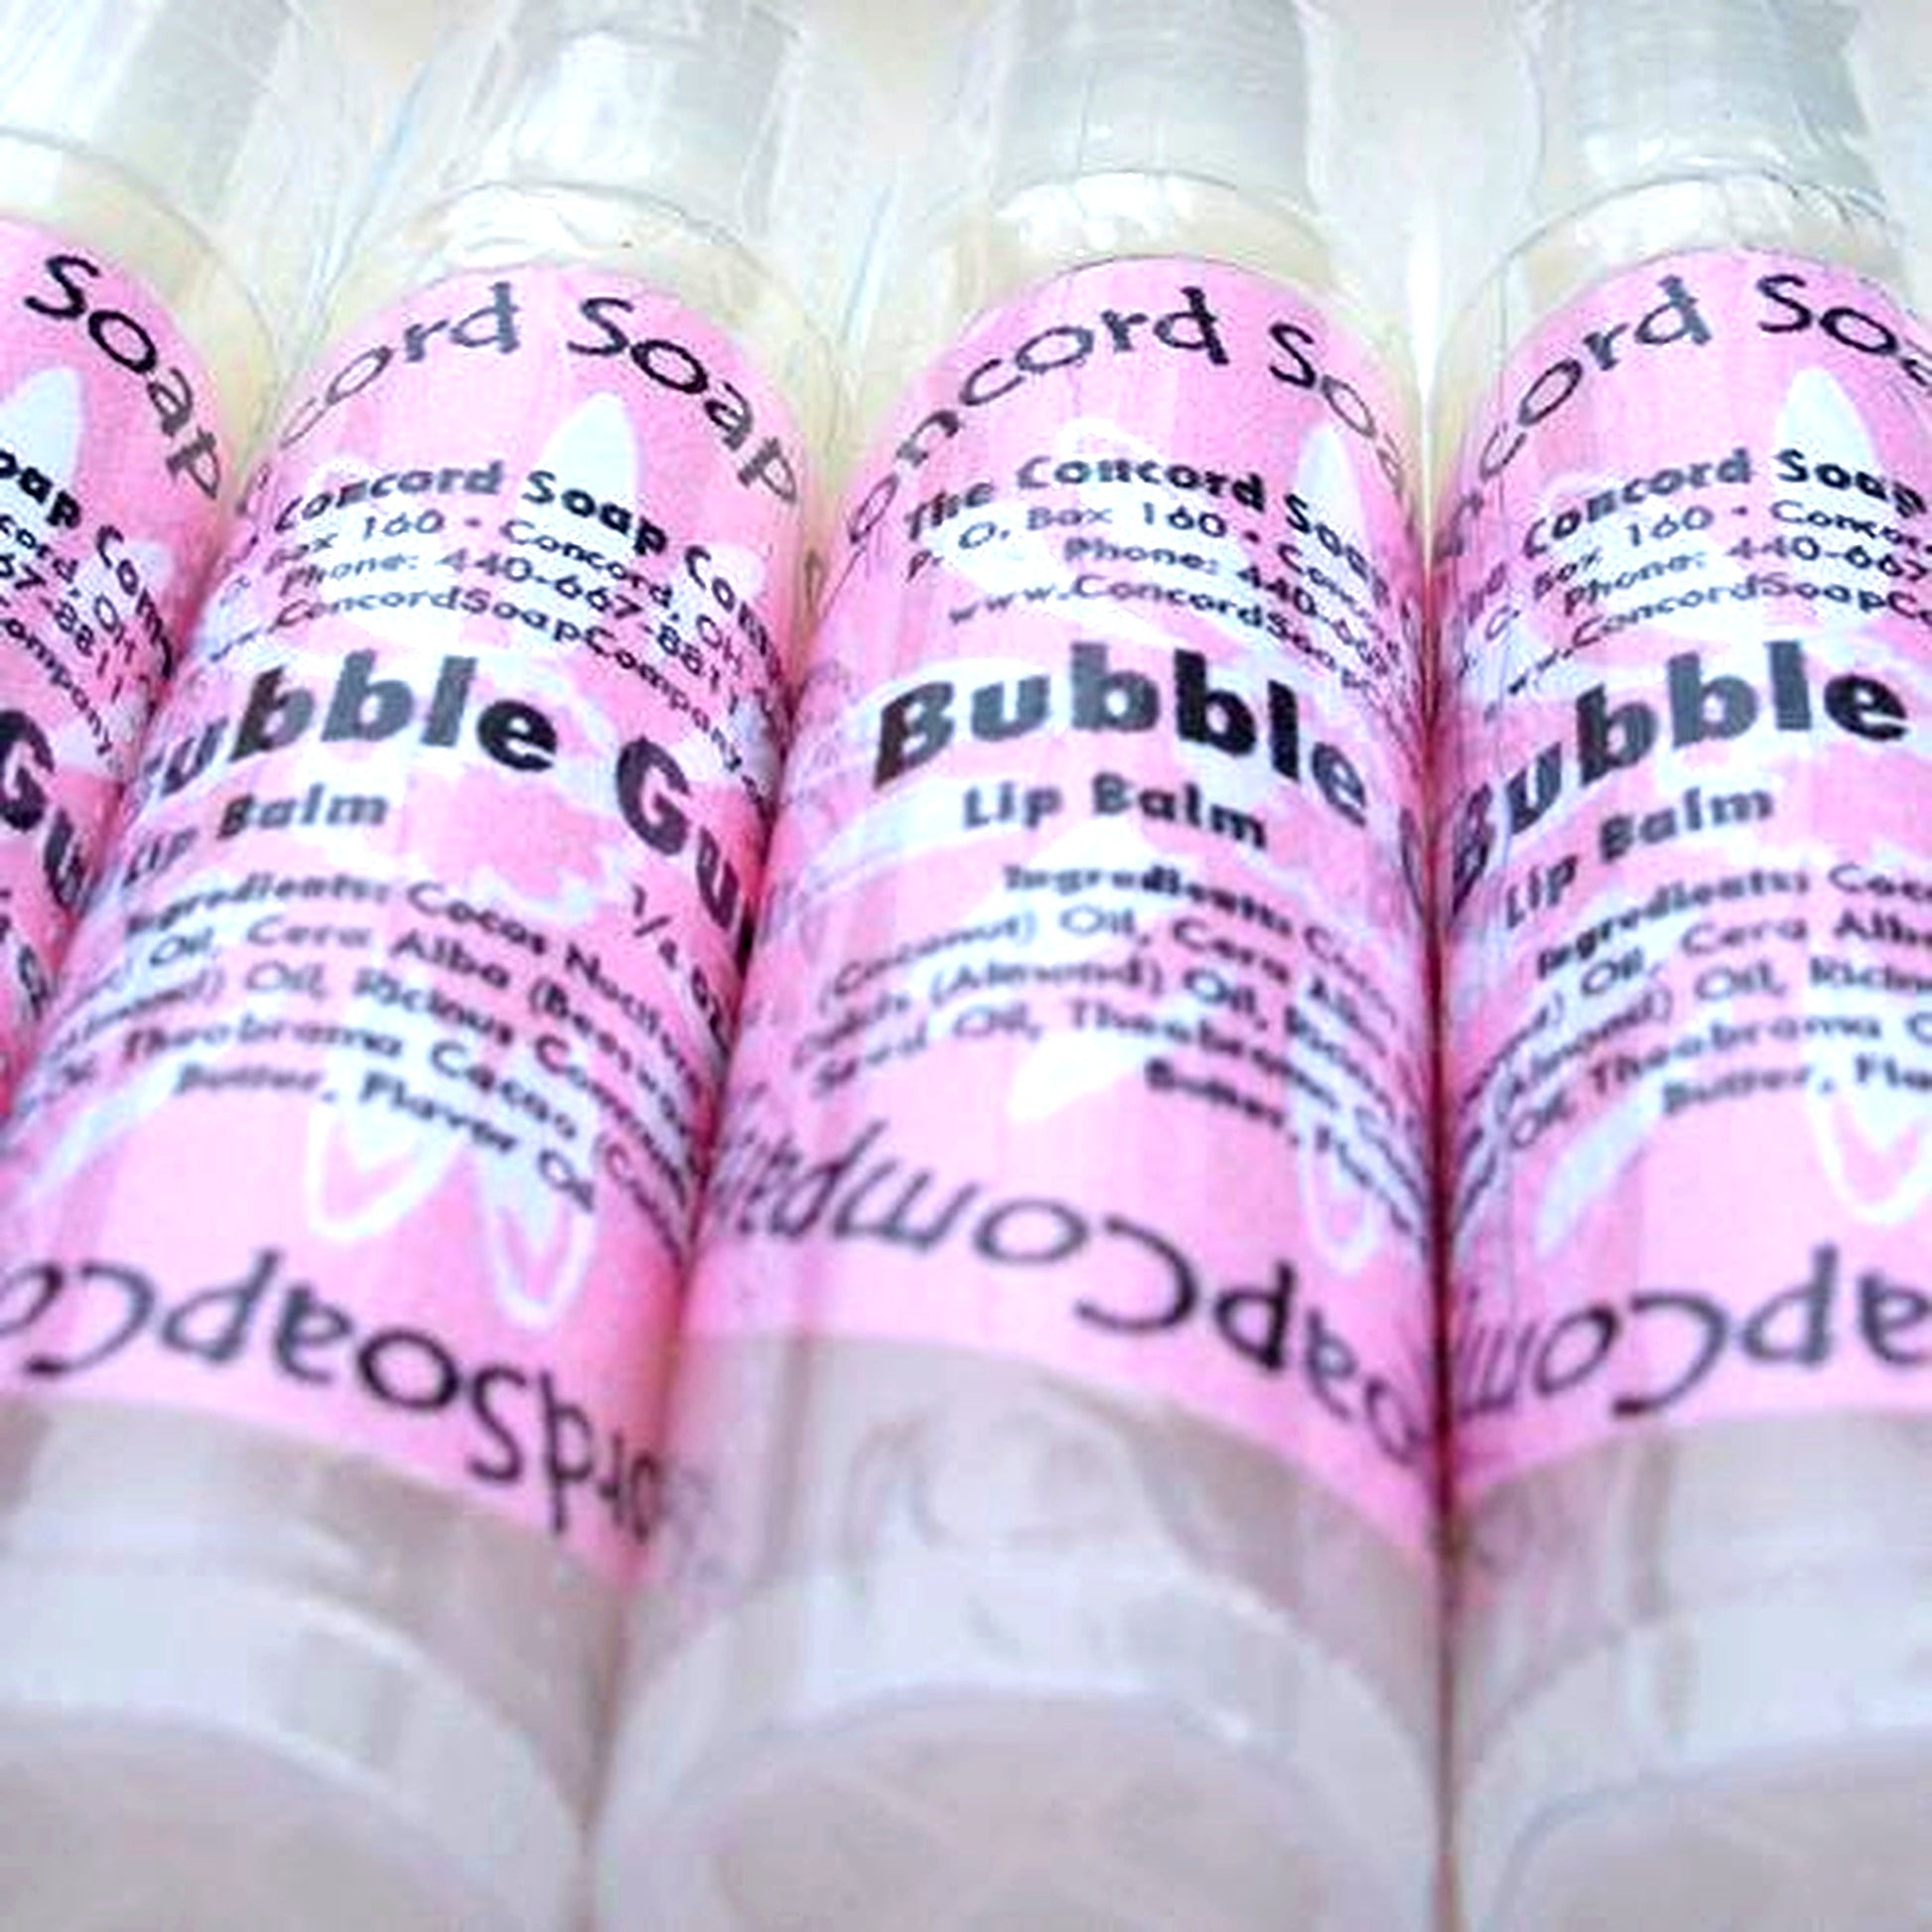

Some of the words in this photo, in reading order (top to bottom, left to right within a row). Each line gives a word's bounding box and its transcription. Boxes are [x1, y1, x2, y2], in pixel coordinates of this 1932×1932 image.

[24, 253, 221, 499] Soap
[566, 296, 797, 504] Soap
[273, 460, 504, 534] Concord
[521, 470, 669, 557] Soap
[903, 481, 996, 542] The
[1015, 454, 1267, 514] Concord
[1026, 501, 1114, 531] Box
[1142, 500, 1229, 540] 160
[1523, 447, 1754, 560] Concord
[1774, 448, 1930, 520] Soap
[1625, 504, 1717, 548] 160
[279, 553, 420, 598] Phone:
[1062, 535, 1220, 578] Phone:
[143, 648, 558, 796] ubble
[873, 640, 1368, 830] Bubble
[216, 782, 389, 840] Balm
[960, 780, 1062, 828] Lip
[1090, 770, 1268, 851] Balm
[1505, 853, 1579, 929] Lip
[1596, 786, 1776, 862] Balm
[389, 929, 512, 991] Alba
[405, 881, 548, 956] Cocos
